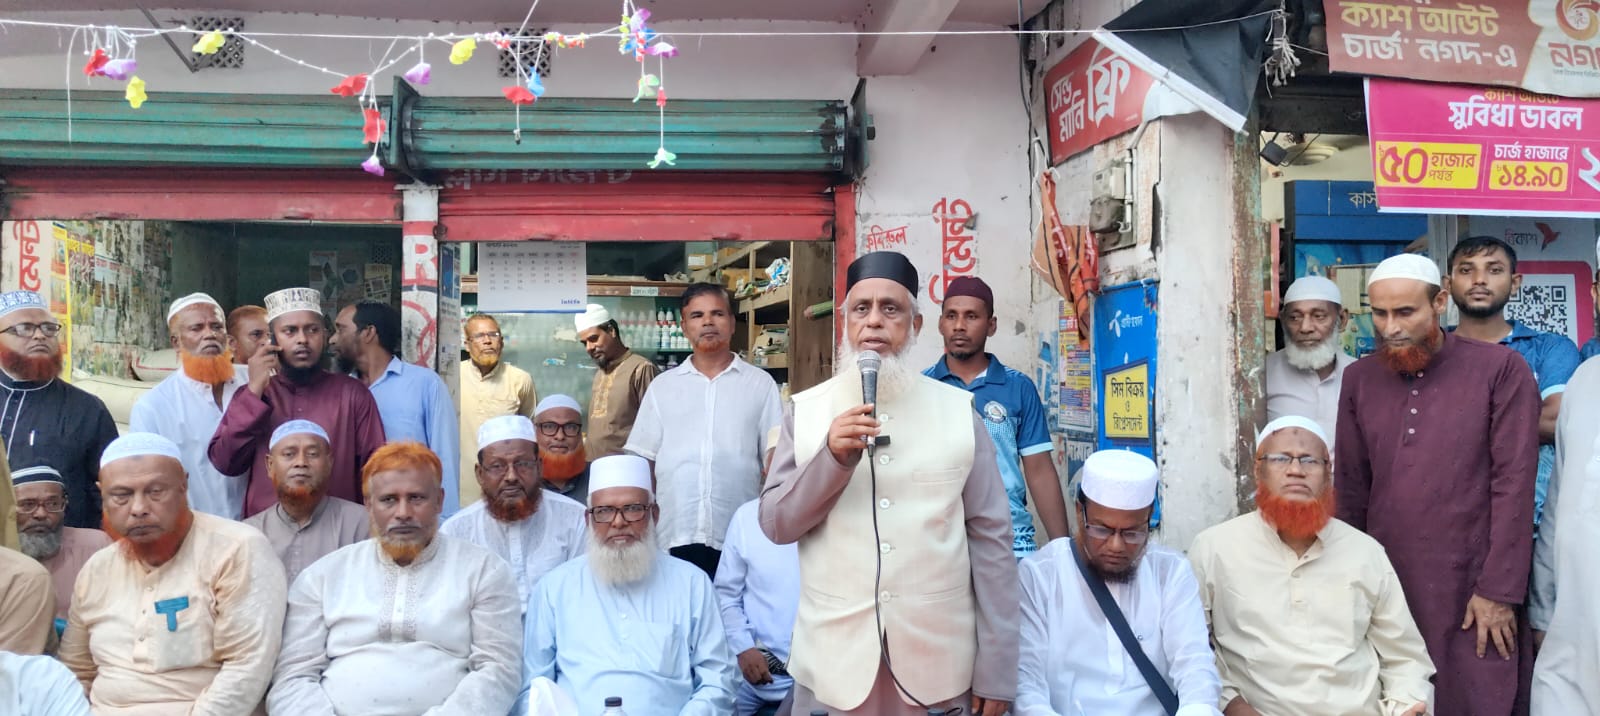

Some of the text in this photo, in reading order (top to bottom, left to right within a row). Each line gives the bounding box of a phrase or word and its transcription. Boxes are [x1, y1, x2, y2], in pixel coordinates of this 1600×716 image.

[1339, 2, 1499, 37] ক্যাশ আউট
[1415, 38, 1518, 68] নগদ-এ
[1548, 41, 1600, 70] নগ
[1448, 95, 1583, 131] সুবিধা ডাবল
[1431, 152, 1477, 168] হাজার
[1494, 141, 1570, 161] চার্জ হাজারে
[1111, 377, 1124, 398] সিম
